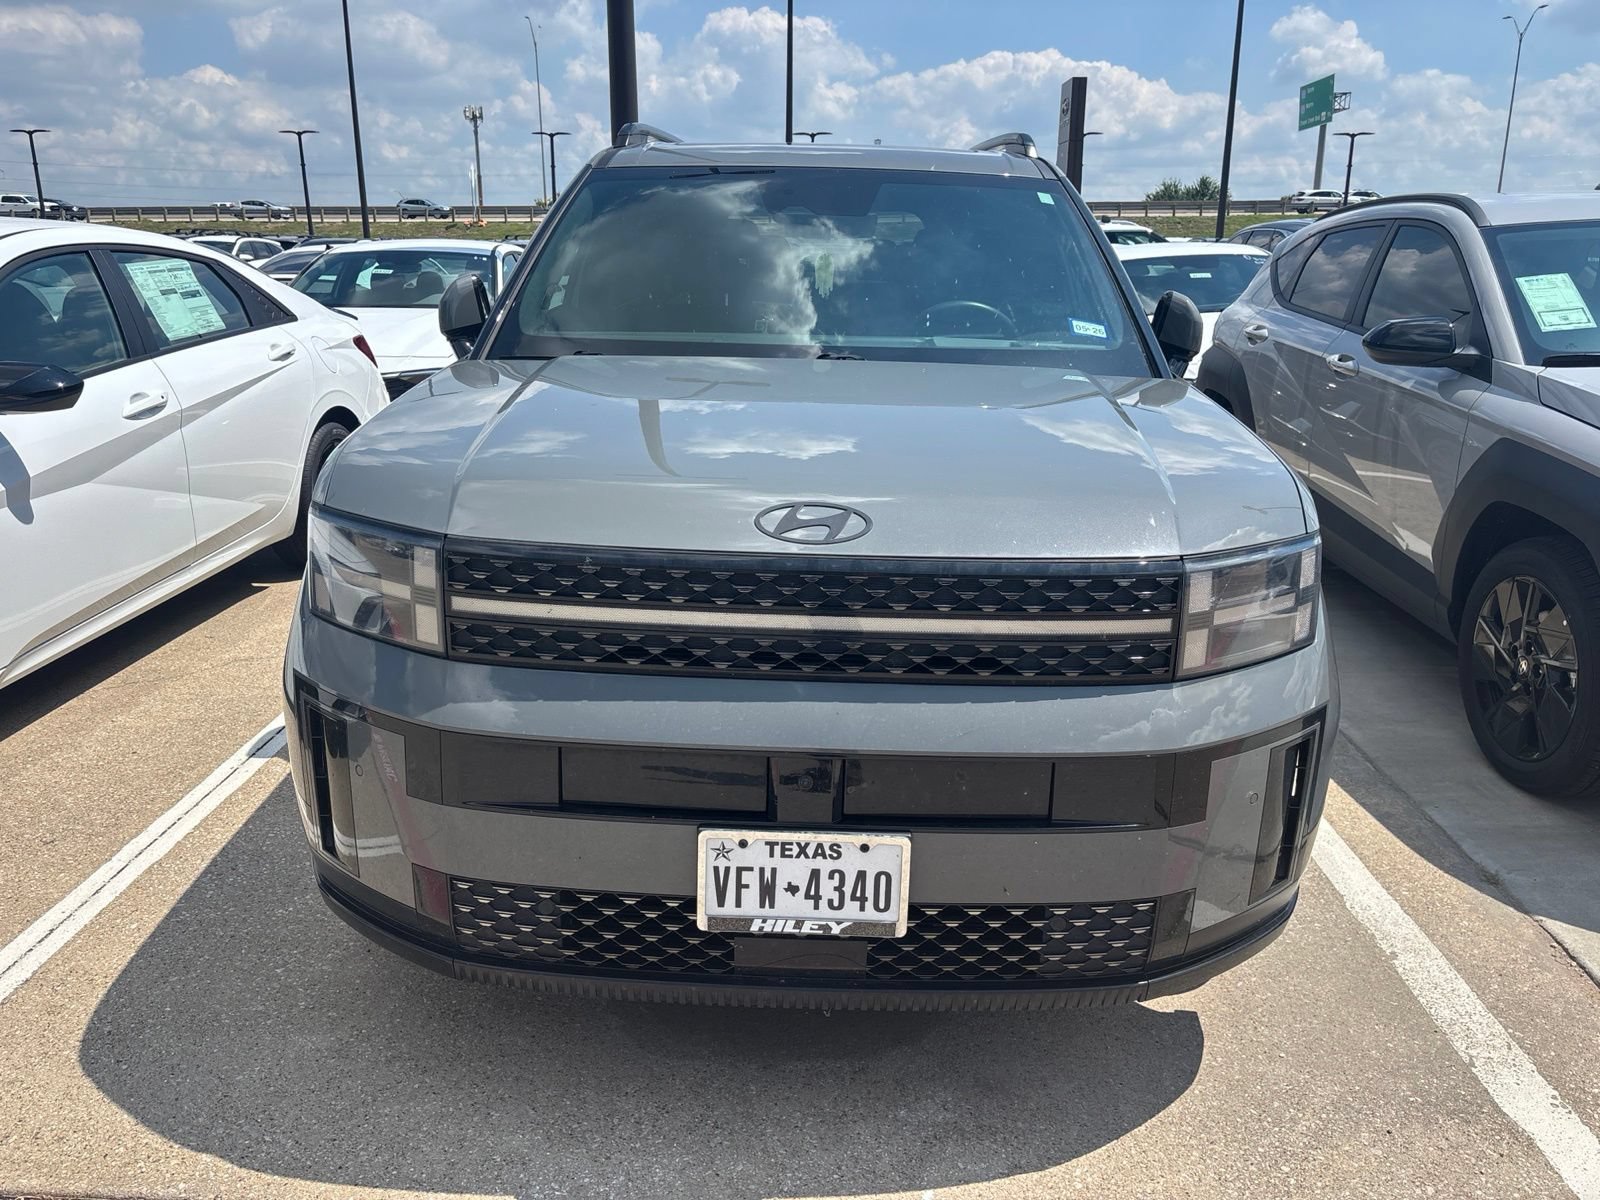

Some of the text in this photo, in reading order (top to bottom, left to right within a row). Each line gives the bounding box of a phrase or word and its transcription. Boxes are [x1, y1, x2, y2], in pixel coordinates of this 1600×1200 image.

[765, 841, 842, 860] TEXAS
[713, 866, 892, 913] VFW 4340
[750, 918, 854, 935] HILEY
